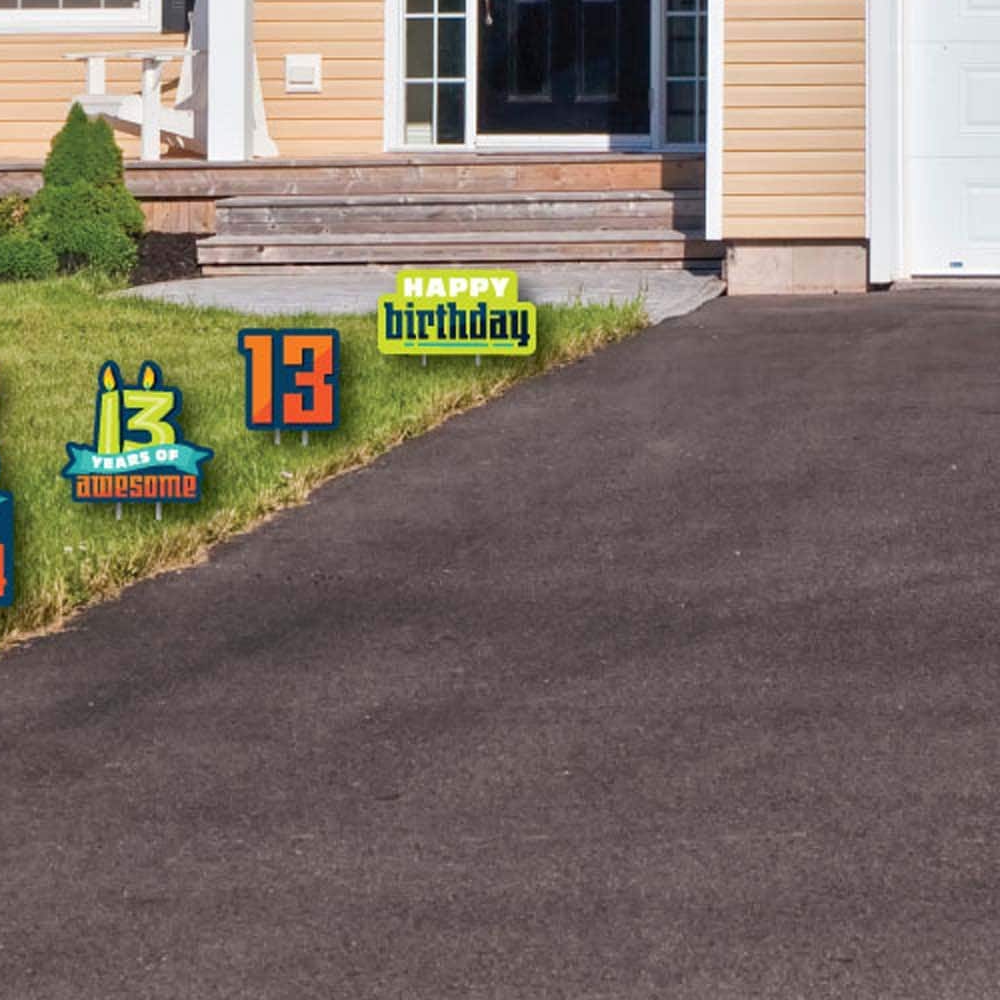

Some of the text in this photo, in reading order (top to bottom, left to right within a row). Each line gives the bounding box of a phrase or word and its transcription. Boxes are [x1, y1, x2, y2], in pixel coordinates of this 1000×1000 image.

[403, 277, 510, 297] HAPPY
[384, 302, 530, 347] birthday
[244, 335, 333, 424] 13
[98, 390, 176, 455] 13
[91, 449, 179, 469] YEARS OF
[76, 475, 197, 498] awesome
